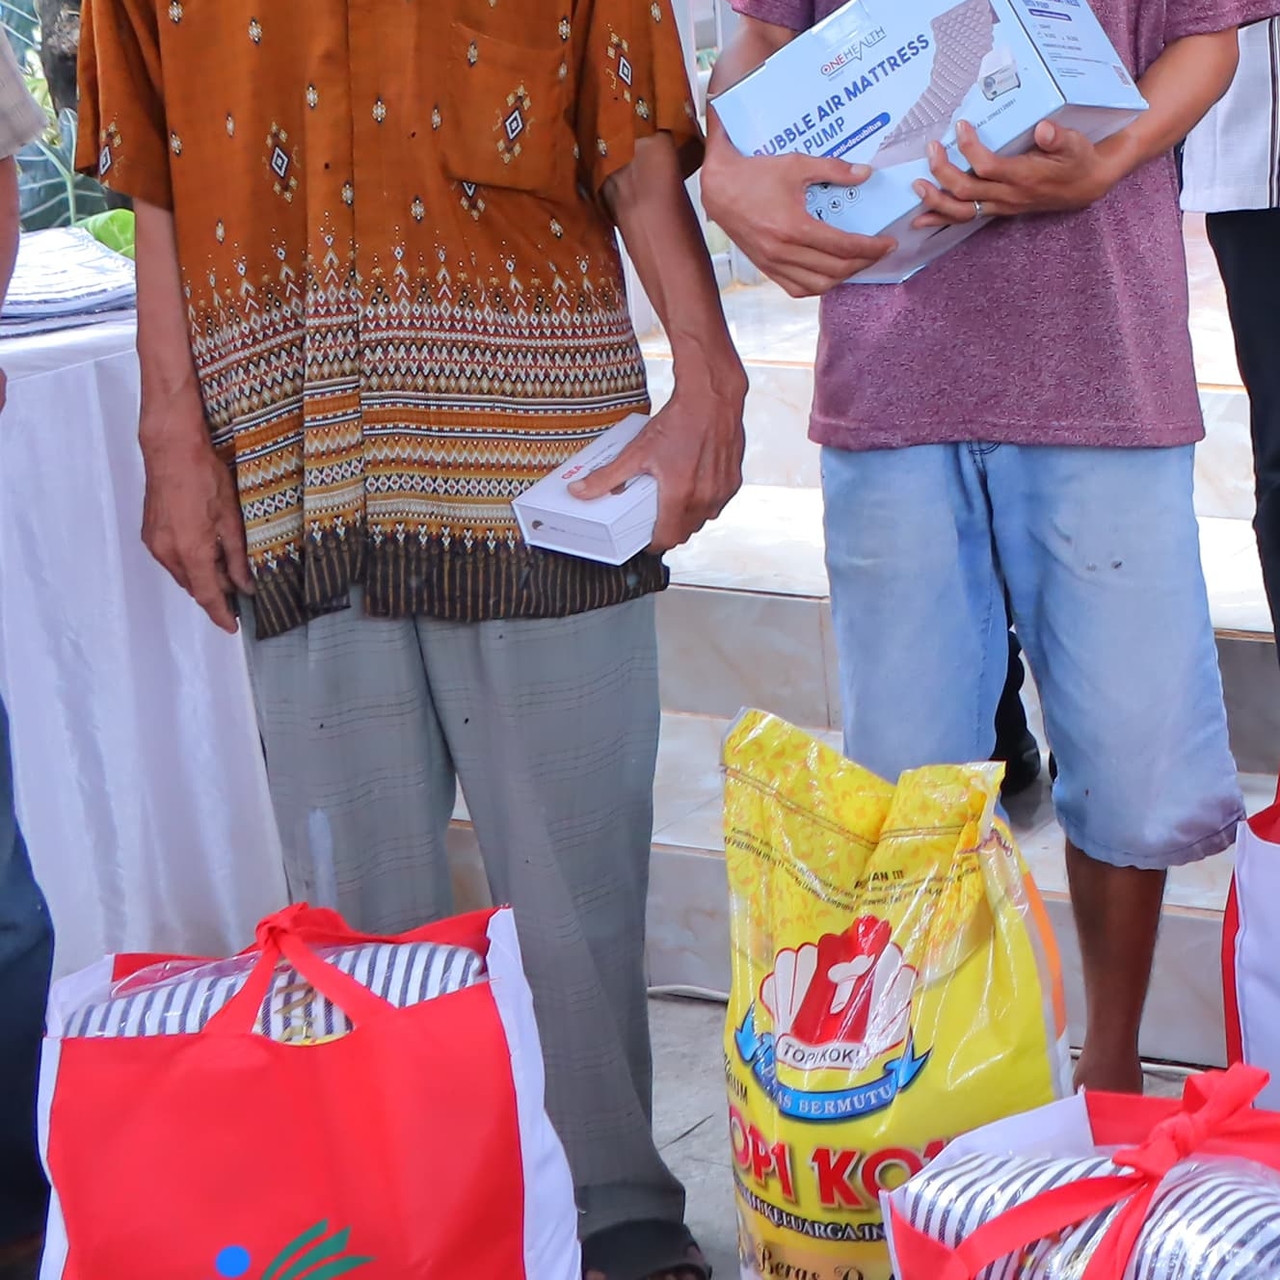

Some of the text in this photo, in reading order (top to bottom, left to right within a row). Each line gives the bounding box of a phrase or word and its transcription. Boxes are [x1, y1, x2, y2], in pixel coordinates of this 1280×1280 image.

[753, 33, 930, 157] BUBBLE AIR MATTRESS
[802, 116, 846, 155] PUMP
[832, 120, 883, 157] anti-decubitus
[783, 1041, 819, 1066] TOPI
[799, 1082, 894, 1115] BERMUTU
[810, 1138, 951, 1209] KO
[765, 1201, 858, 1242] KELUARGA
